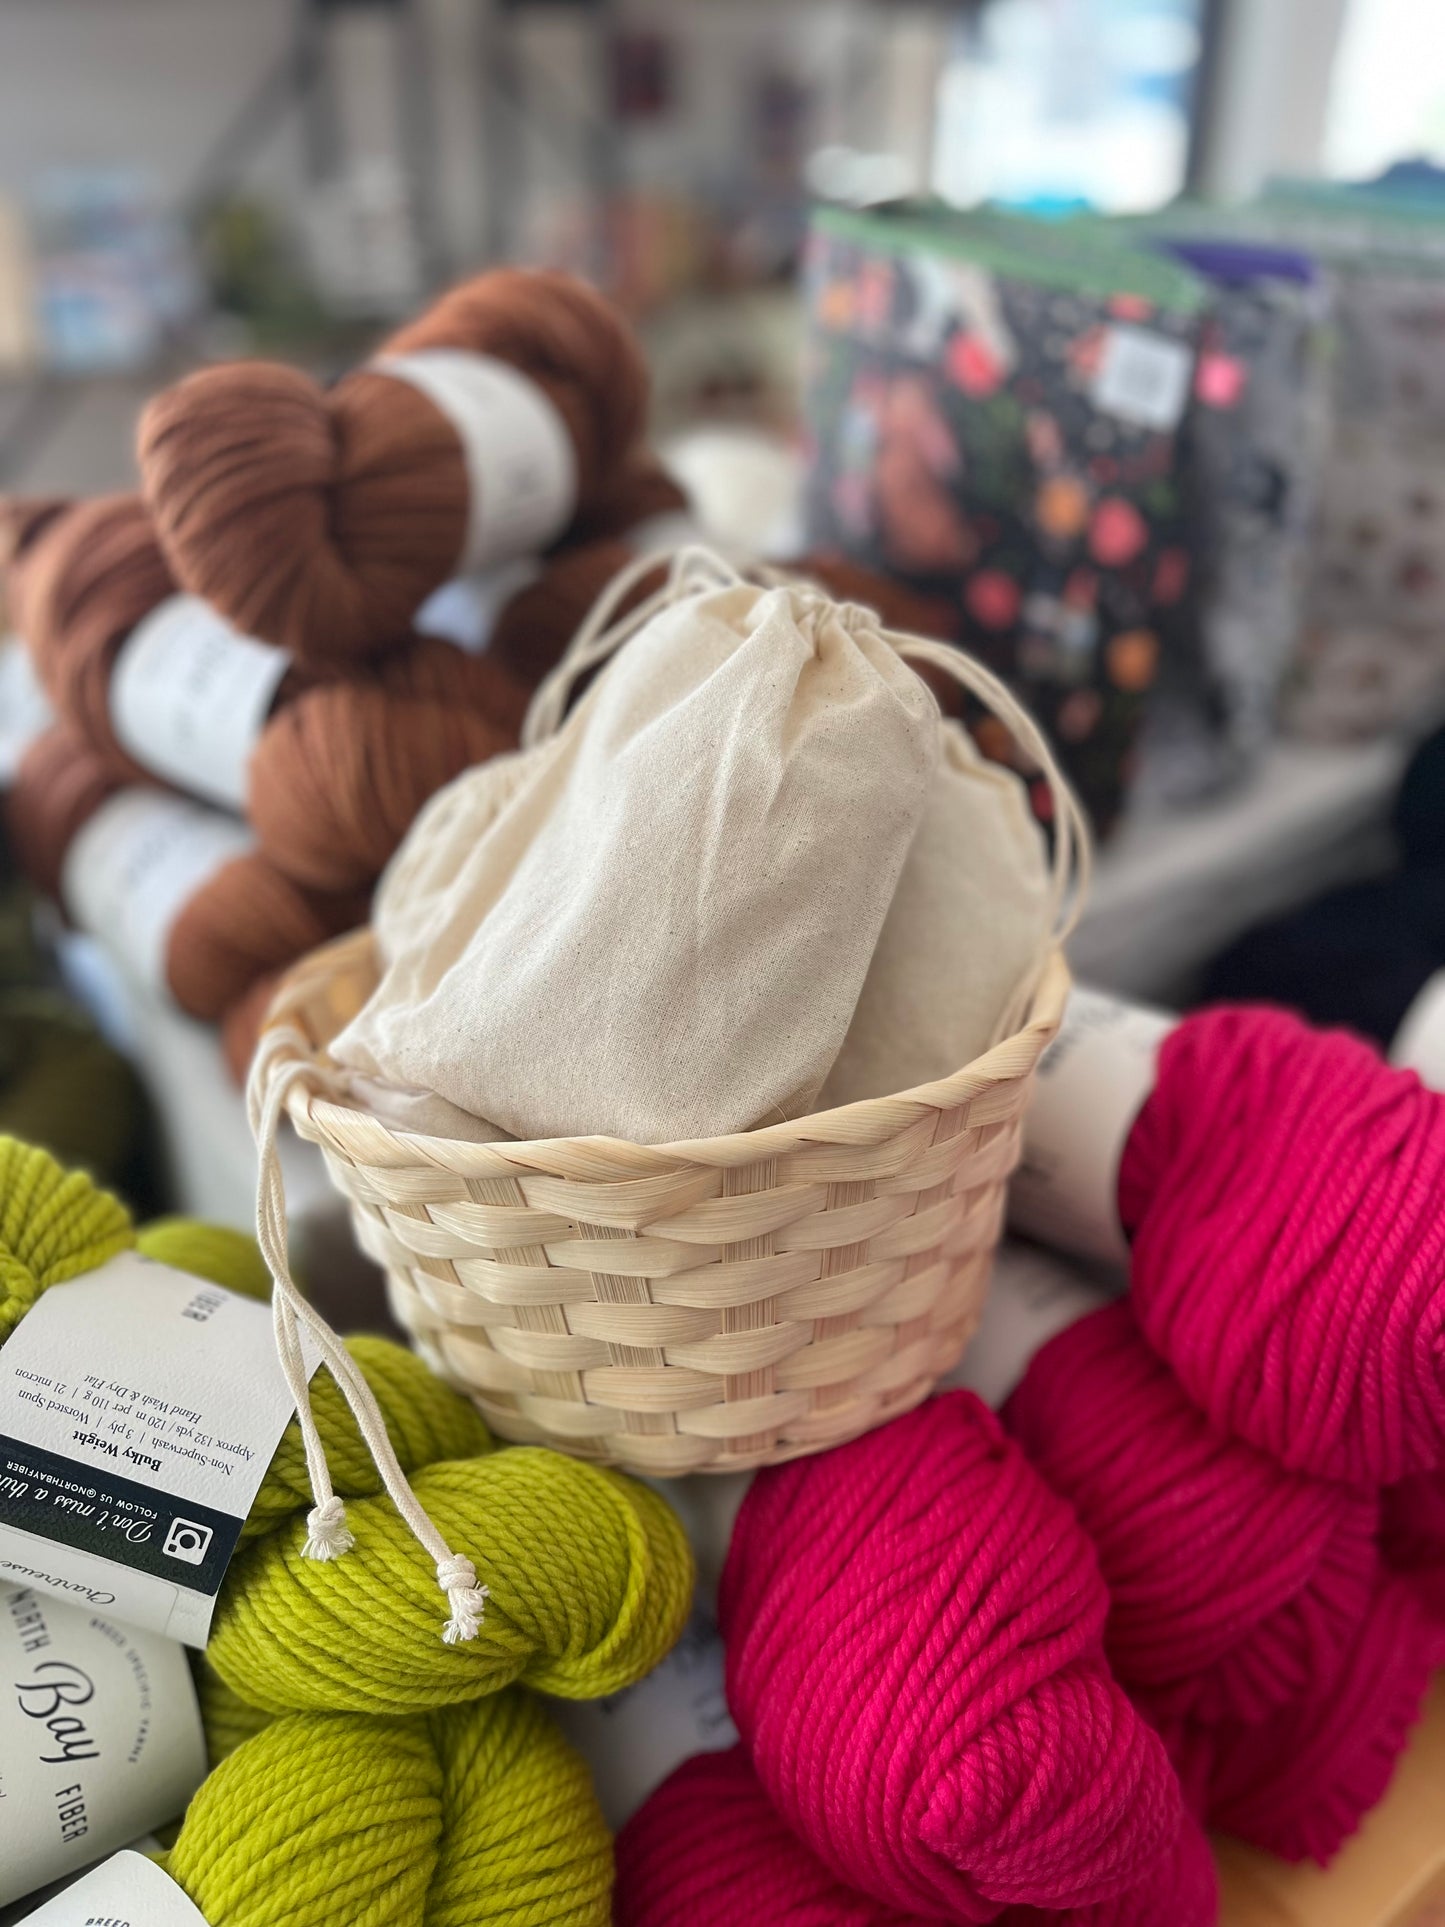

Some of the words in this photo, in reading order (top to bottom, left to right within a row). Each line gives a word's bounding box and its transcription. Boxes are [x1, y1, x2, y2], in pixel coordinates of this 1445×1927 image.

[15, 1368, 52, 1387] micron
[83, 1374, 107, 1390] Flat
[53, 1382, 67, 1395] 21
[83, 1389, 93, 1400] g
[106, 1381, 129, 1398] Dry
[129, 1390, 141, 1401] &
[18, 1389, 46, 1408] Spun
[91, 1396, 110, 1410] 110
[142, 1394, 169, 1413] Wash
[46, 1400, 89, 1425] Worsted
[112, 1403, 133, 1415] per
[135, 1411, 147, 1420] m
[169, 1405, 202, 1425] Hand
[108, 1420, 127, 1434] ply
[147, 1416, 166, 1431] 120
[175, 1425, 195, 1437] yds
[72, 1430, 118, 1457] Weight
[125, 1429, 134, 1439] 3
[194, 1432, 213, 1447] 132
[122, 1446, 162, 1472] Bulky
[151, 1437, 234, 1476] Non-Superwash
[216, 1440, 255, 1461] Approx
[6, 1460, 97, 1498] @NORTHBAYFIBER
[34, 1488, 49, 1500] a
[99, 1493, 113, 1504] US
[53, 1495, 96, 1516] miss
[116, 1499, 158, 1520] FOLLOW
[96, 1510, 153, 1543] Don't
[0, 1560, 115, 1604] Chartreuse
[14, 1661, 101, 1763] Bay
[55, 1783, 88, 1843] FIBER
